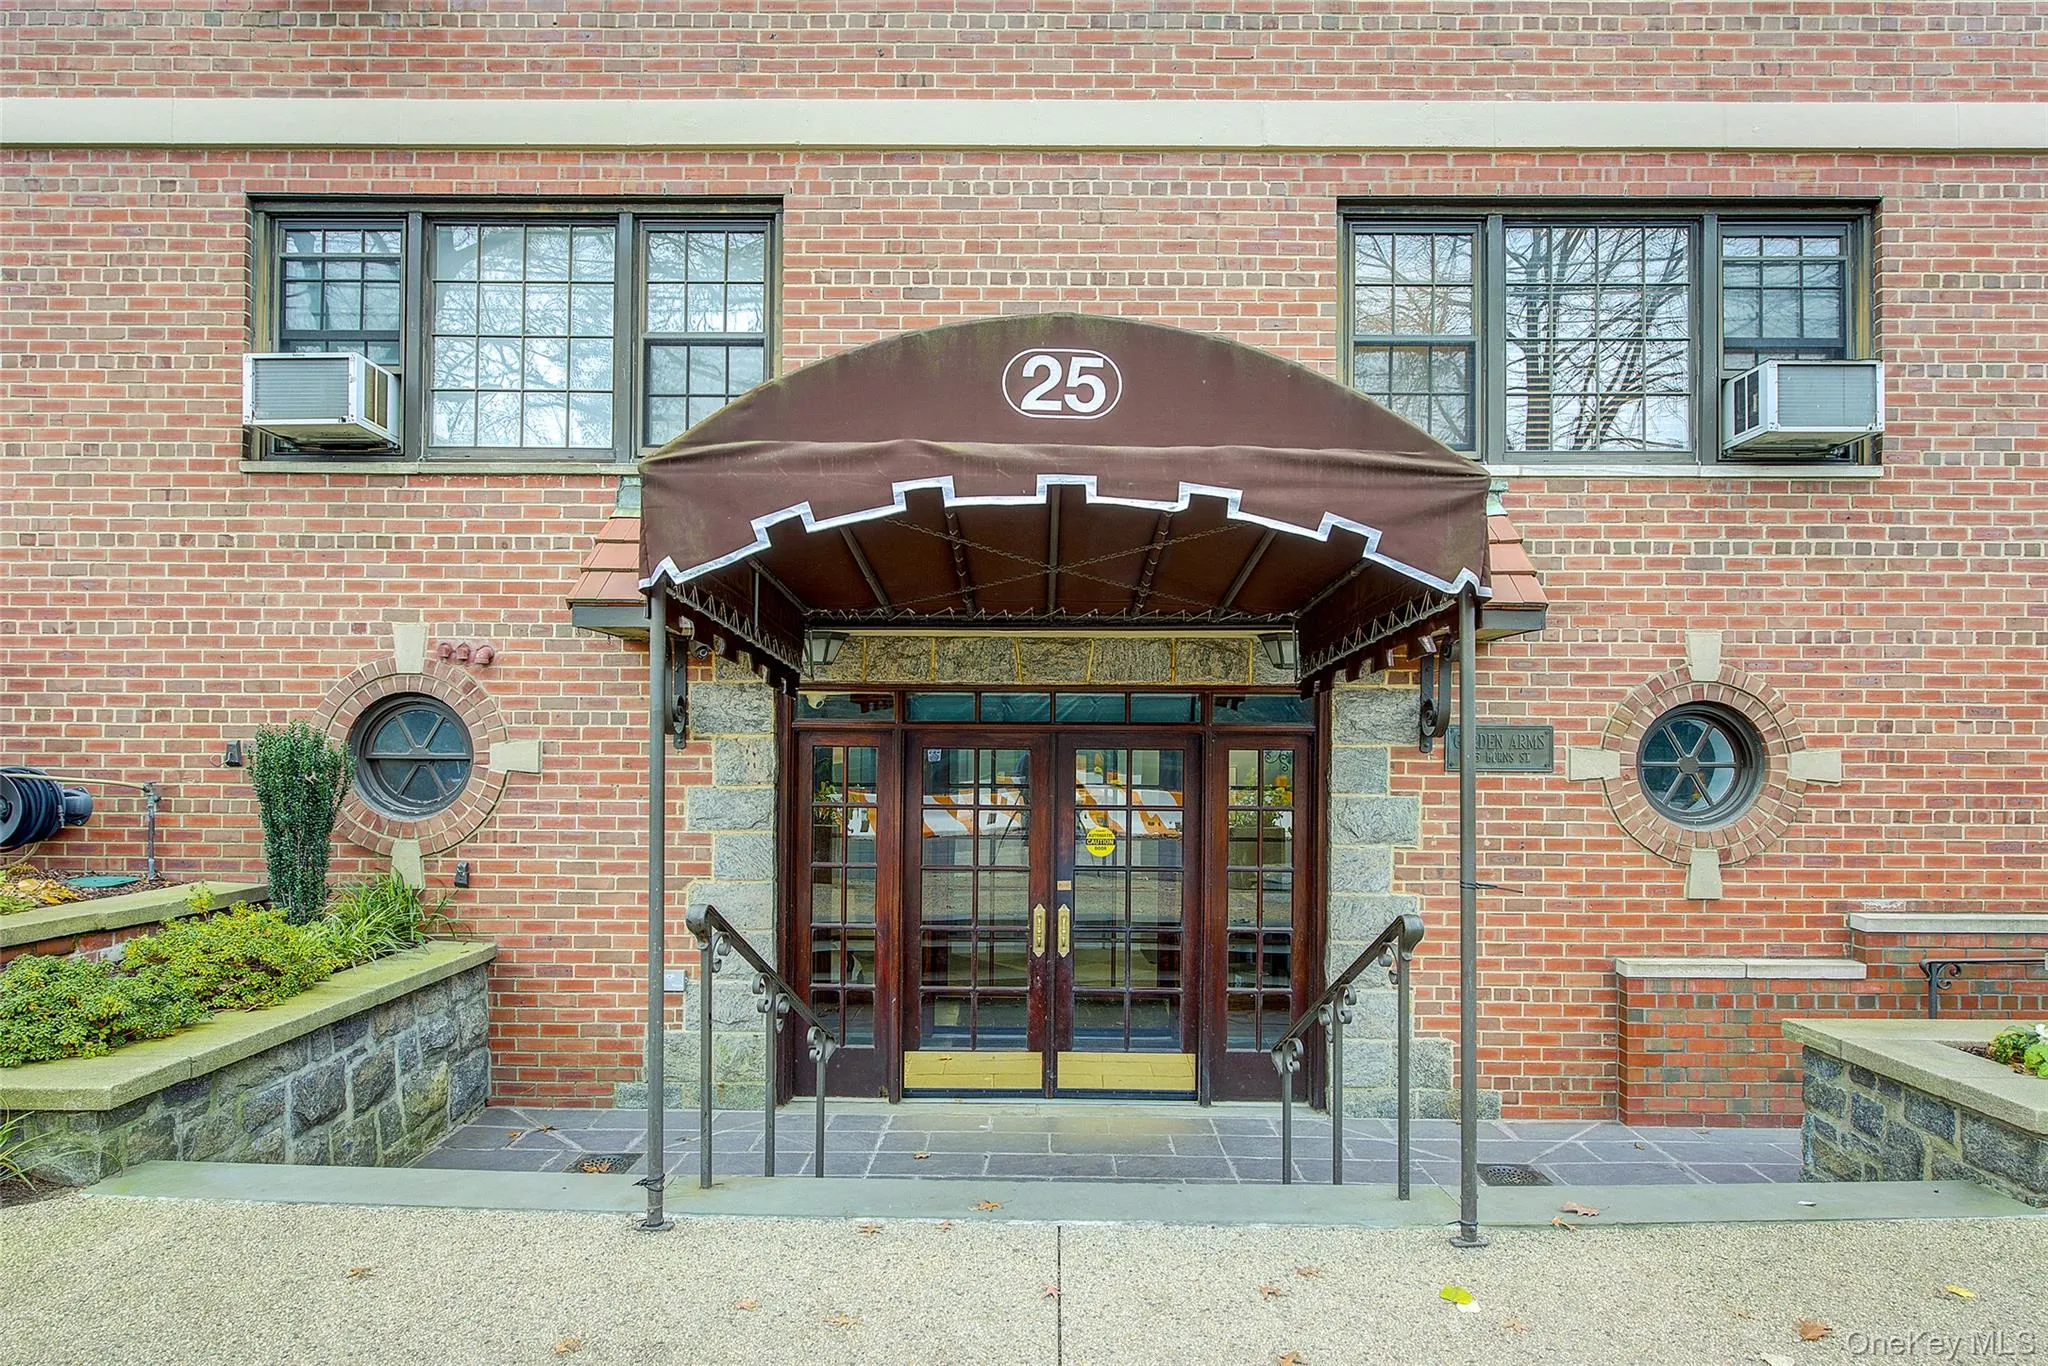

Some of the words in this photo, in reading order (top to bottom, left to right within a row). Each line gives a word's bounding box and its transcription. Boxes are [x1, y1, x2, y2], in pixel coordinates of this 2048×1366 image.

[1020, 354, 1107, 413] 25
[1454, 733, 1504, 750] GDEN
[1508, 733, 1546, 750] ARMS
[1485, 752, 1514, 763] BURNS
